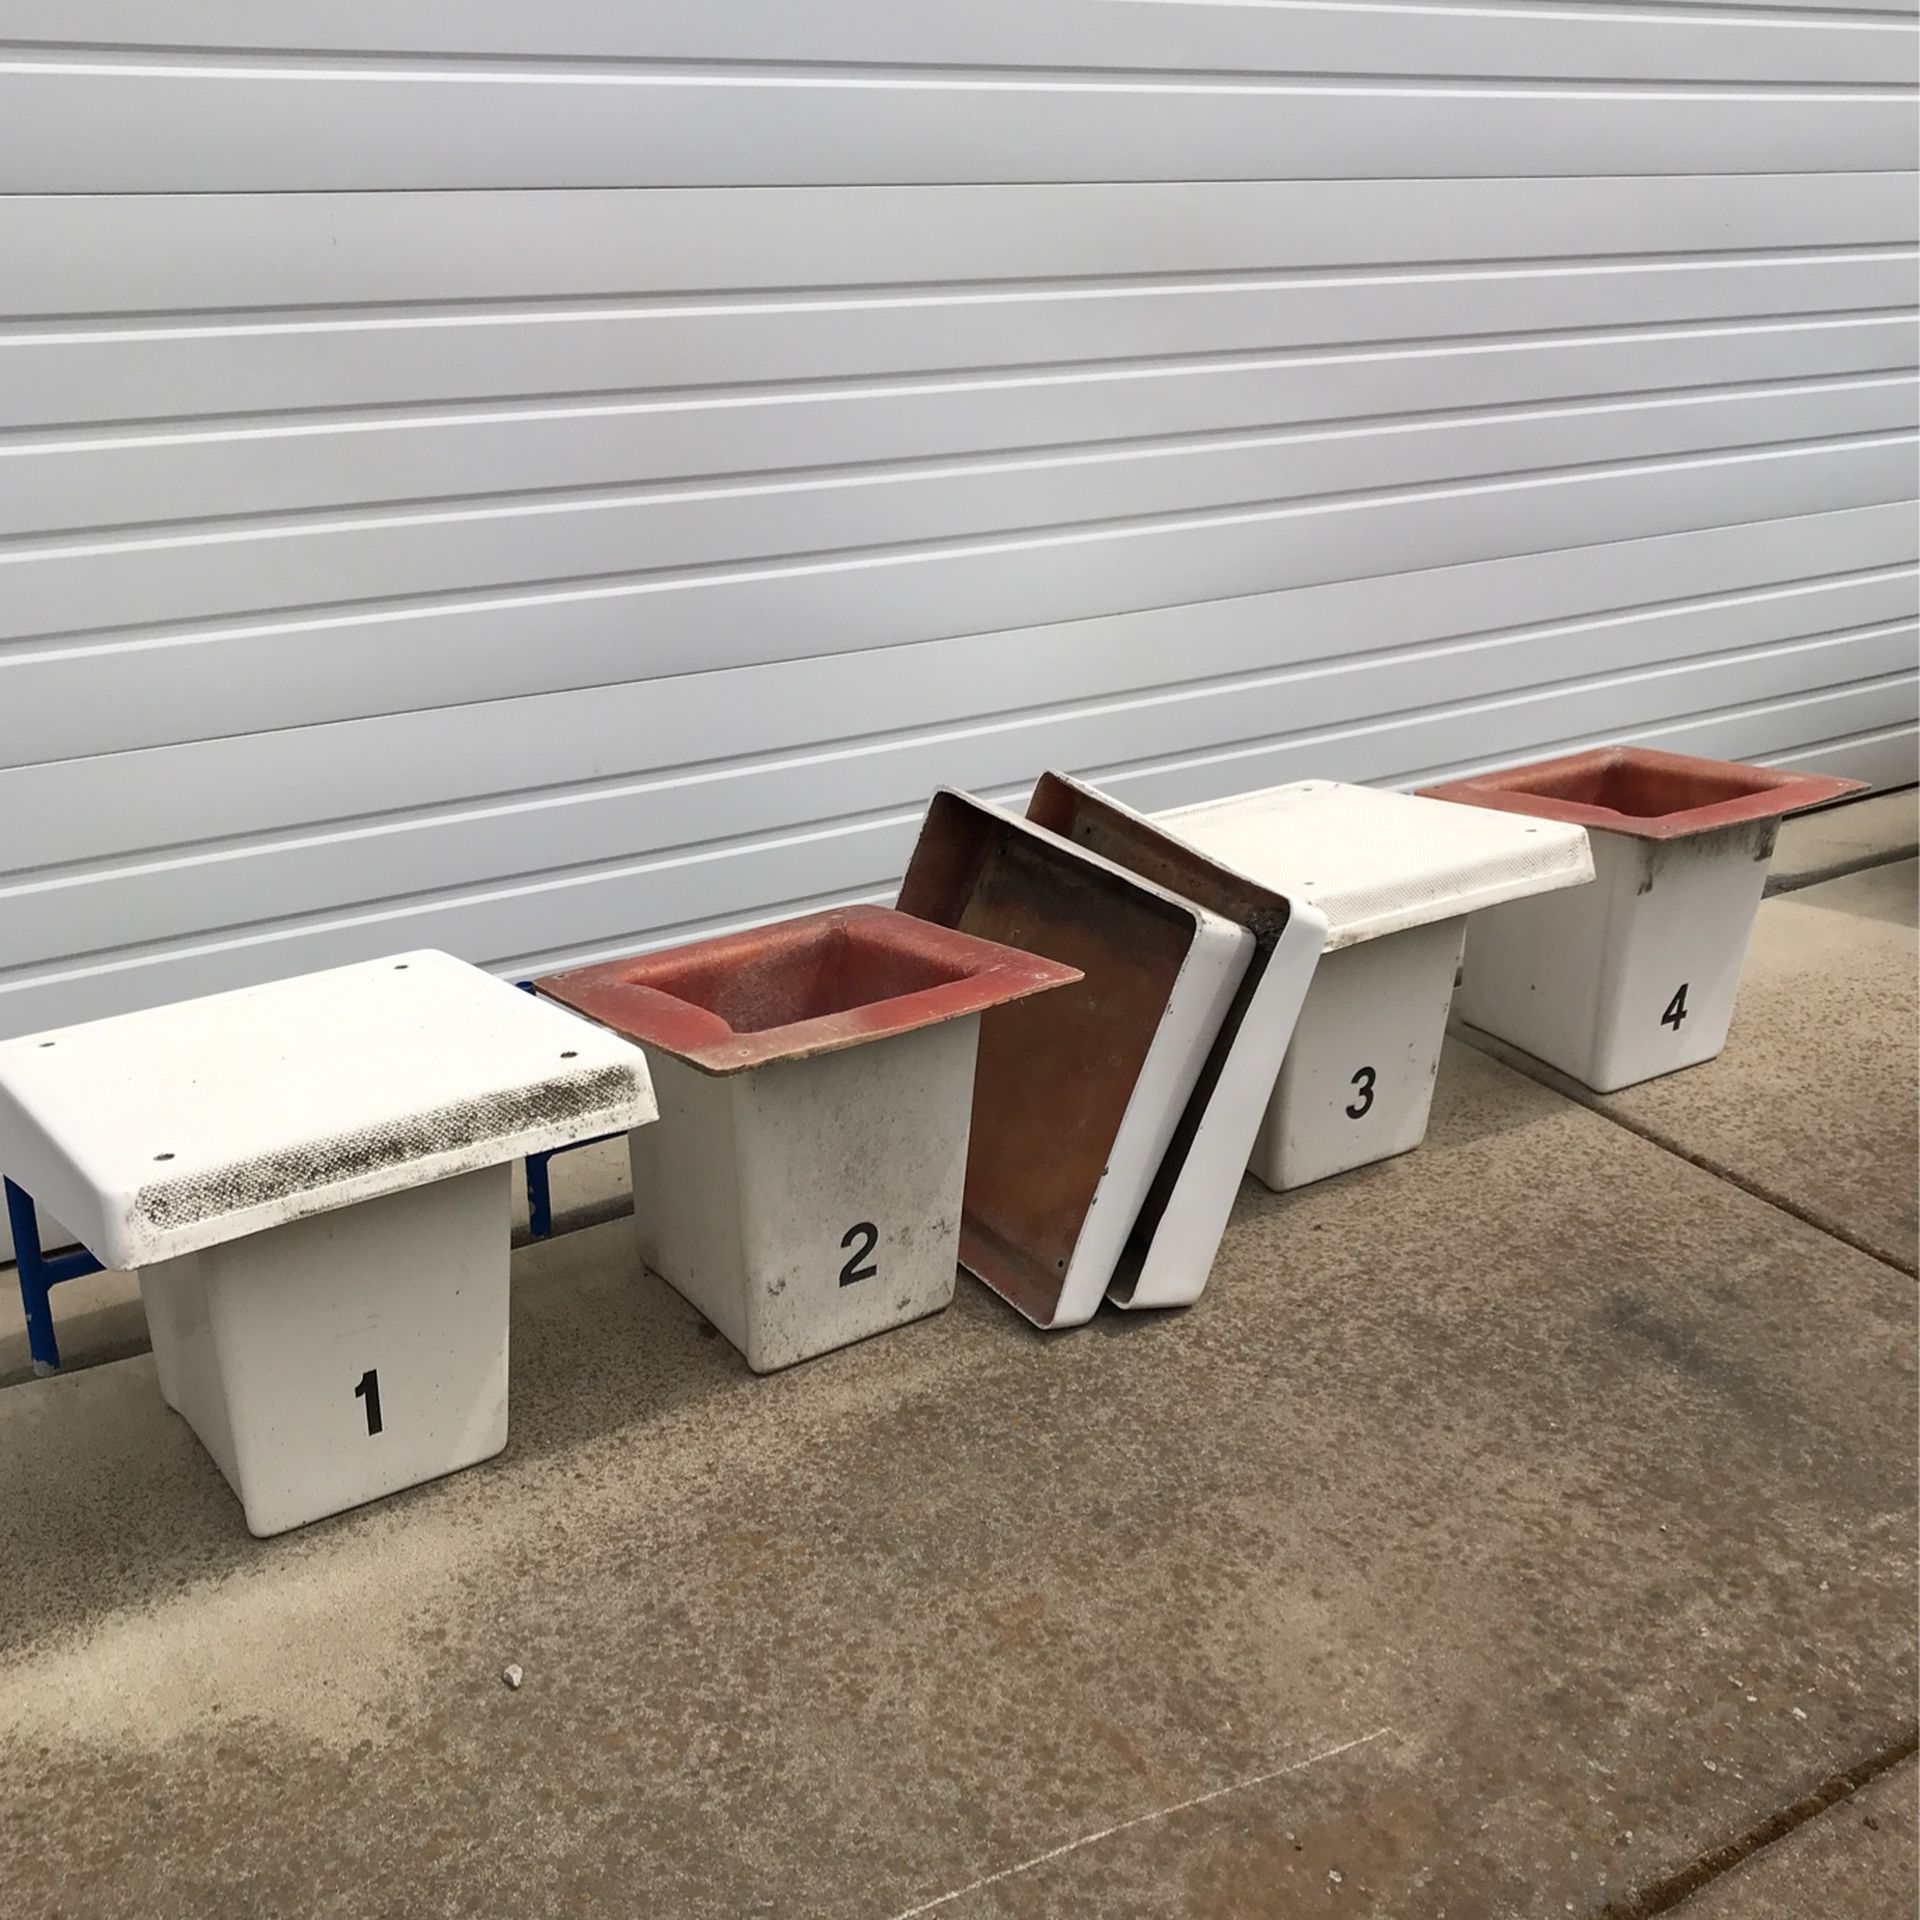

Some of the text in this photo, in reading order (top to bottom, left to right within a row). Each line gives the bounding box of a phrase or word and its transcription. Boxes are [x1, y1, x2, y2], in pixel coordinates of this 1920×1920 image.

[1660, 983, 1689, 1031] 4
[1345, 1066, 1377, 1120] 3
[838, 1221, 879, 1288] 2
[354, 1368, 383, 1437] 1
